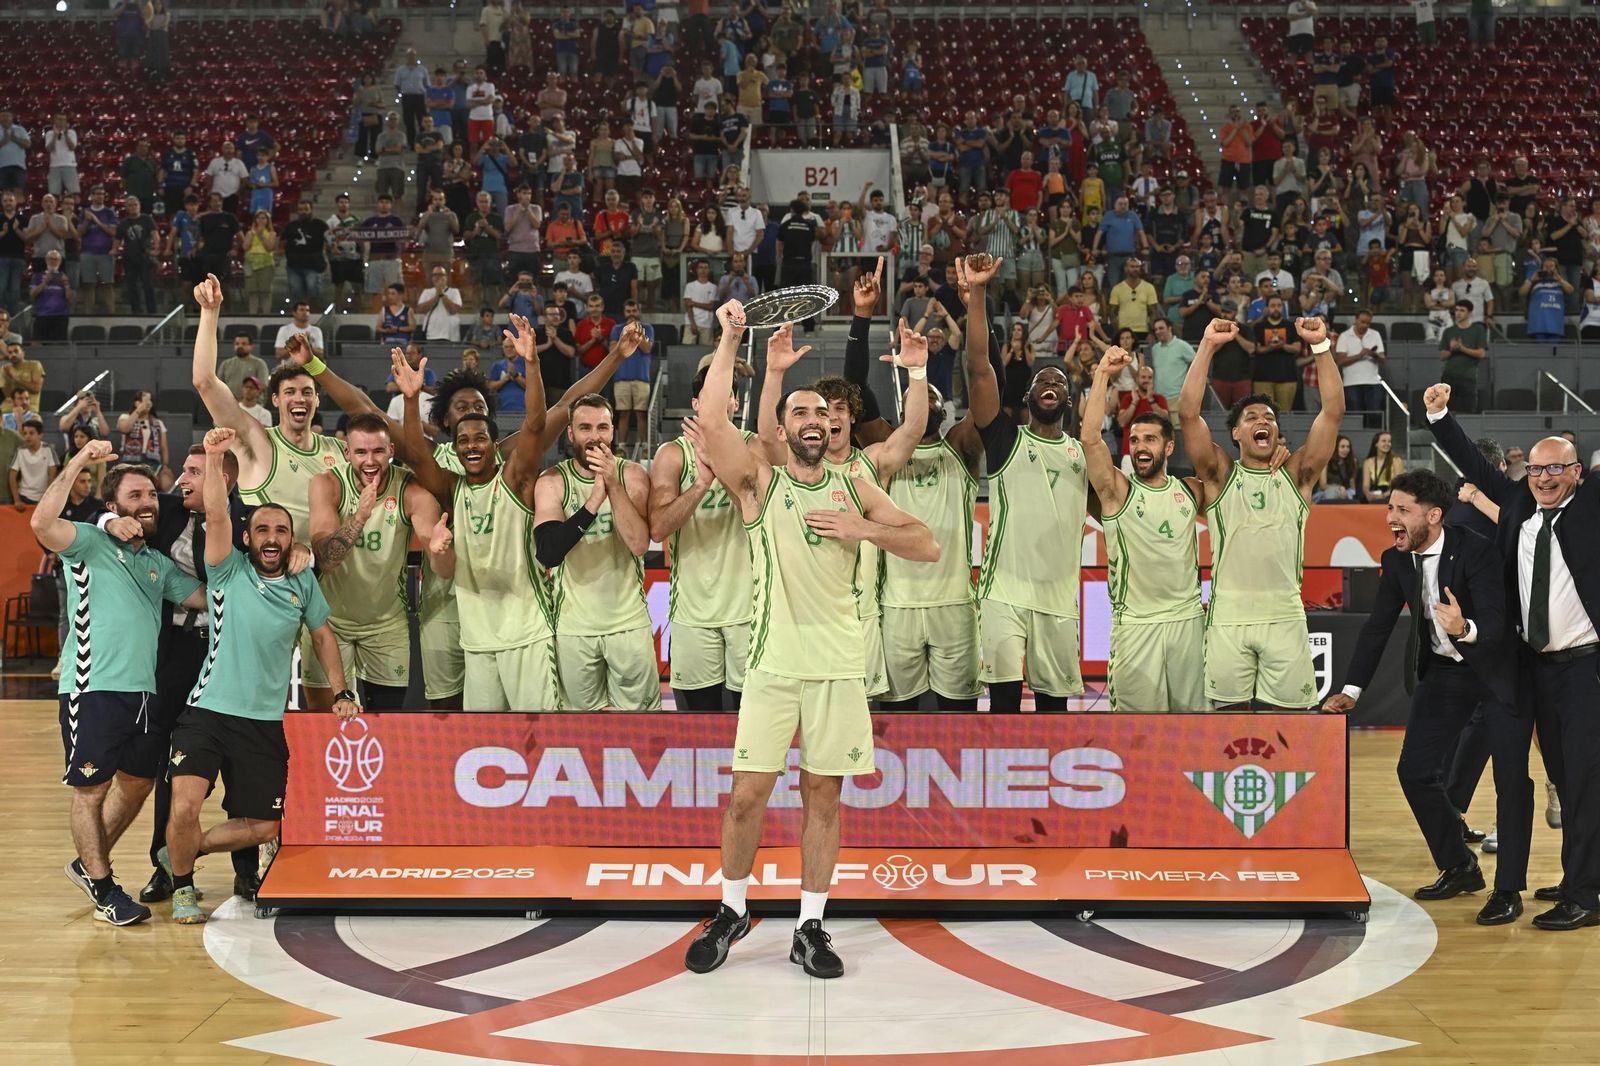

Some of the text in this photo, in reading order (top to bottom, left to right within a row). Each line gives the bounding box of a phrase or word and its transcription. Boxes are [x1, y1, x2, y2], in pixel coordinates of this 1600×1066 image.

[805, 167, 838, 186] B21
[1046, 468, 1060, 489] 7
[702, 488, 731, 509] 22
[1251, 491, 1266, 510] 3
[471, 513, 494, 534] 32
[1158, 519, 1174, 539] 4
[325, 805, 384, 817] FINAL
[328, 867, 535, 879] MADRID2025
[1084, 869, 1300, 882] PRIMERA FEB
